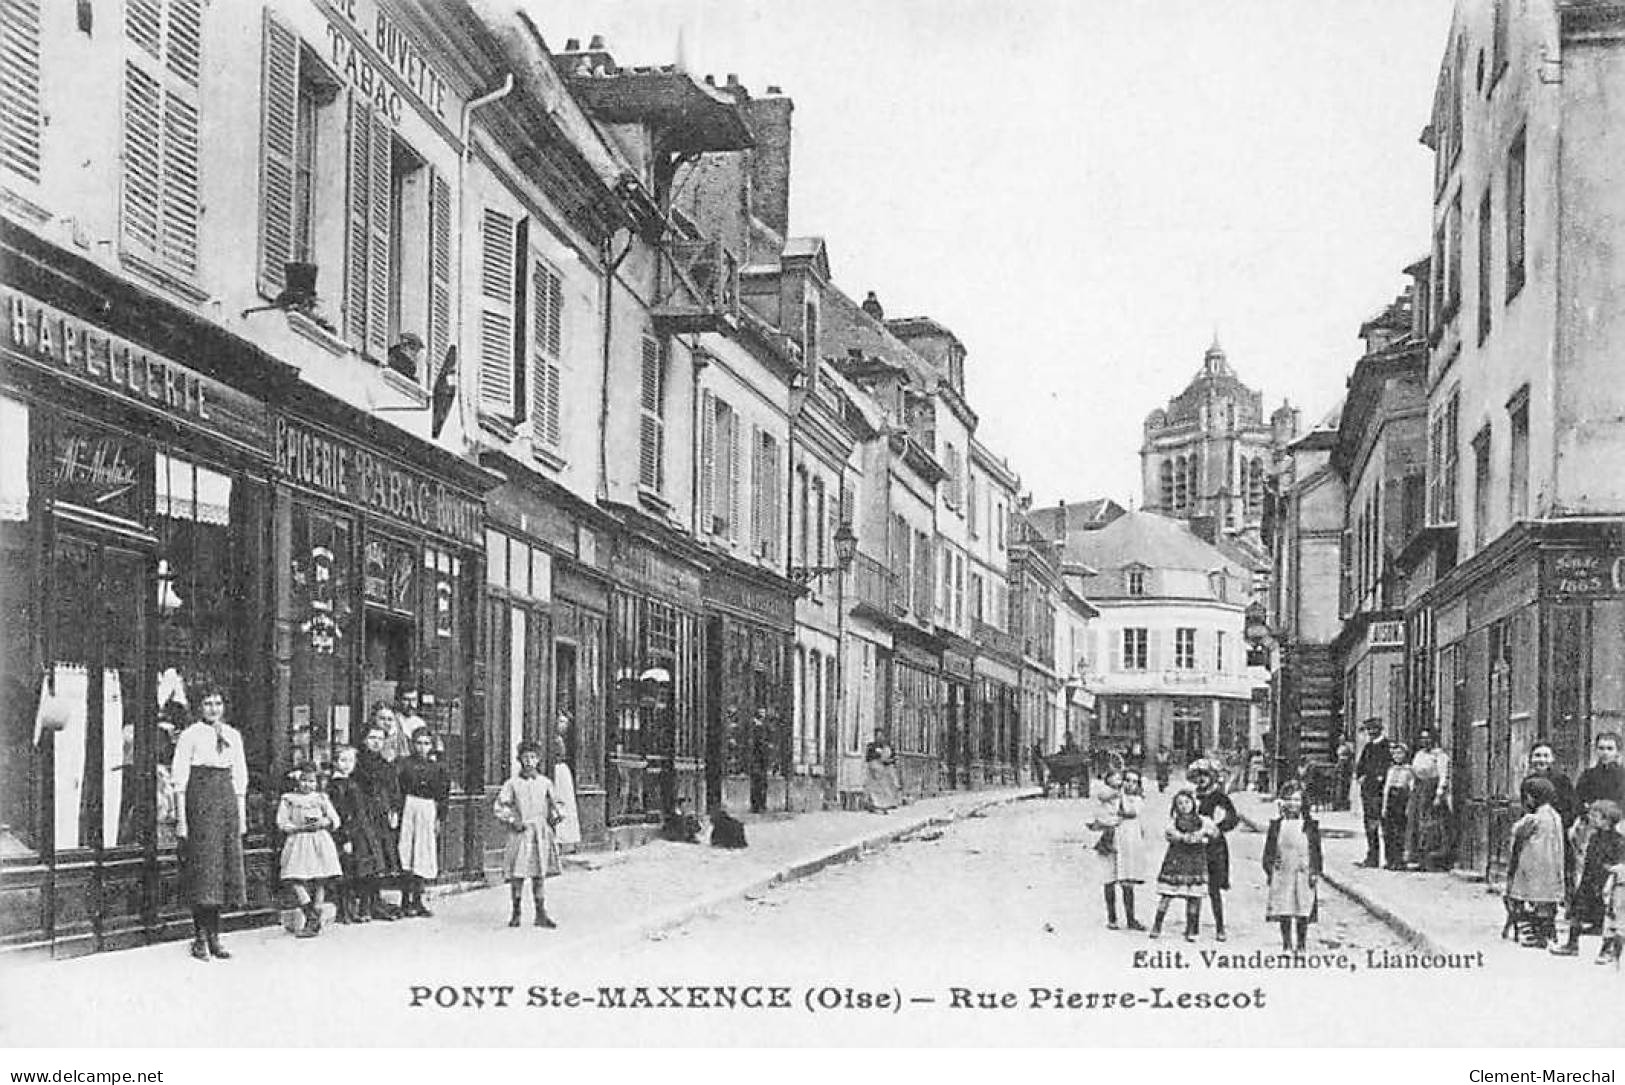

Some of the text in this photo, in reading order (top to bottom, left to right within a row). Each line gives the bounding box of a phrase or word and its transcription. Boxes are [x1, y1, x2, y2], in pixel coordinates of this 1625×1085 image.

[327, 23, 401, 125] TABAC
[376, 13, 446, 119] BUVETTE
[275, 411, 347, 494] EPICERIE
[354, 450, 432, 525] TABAC
